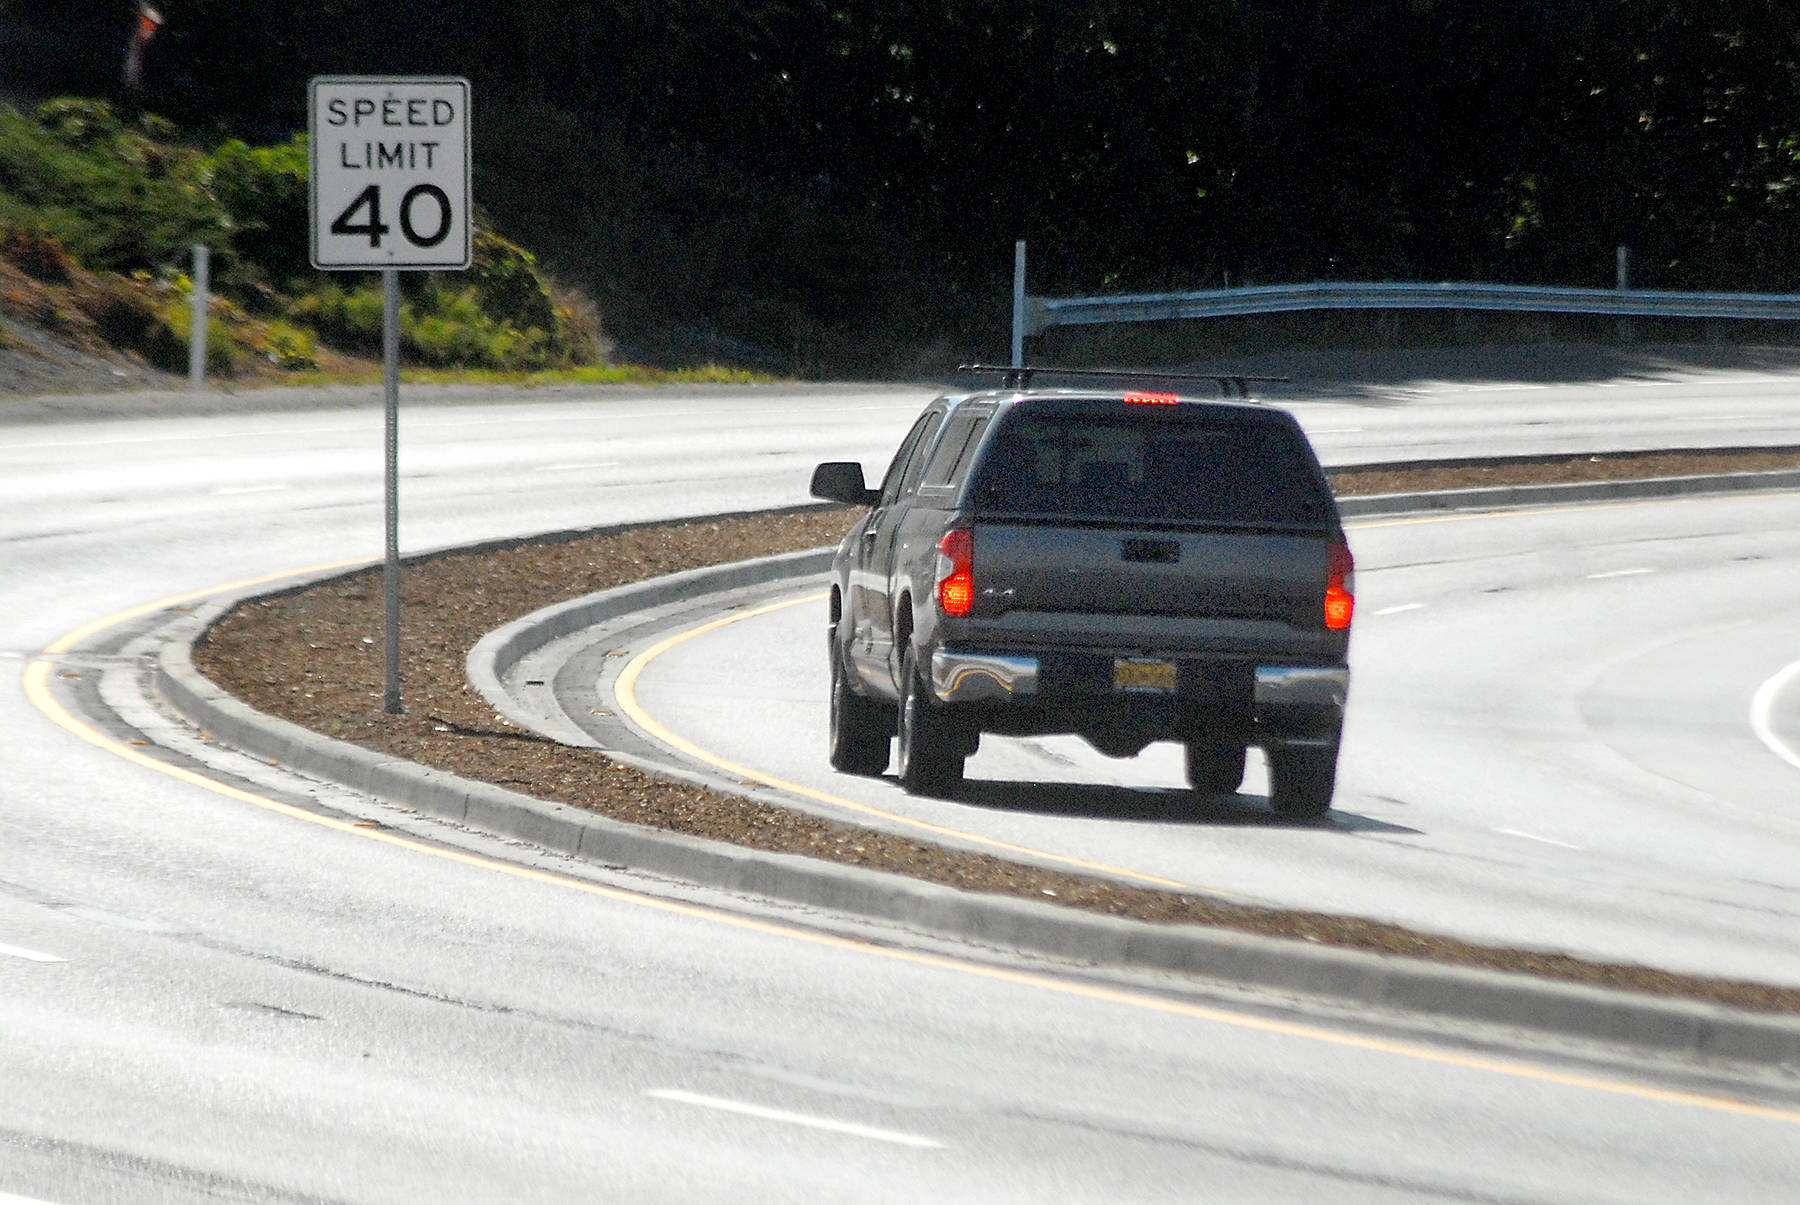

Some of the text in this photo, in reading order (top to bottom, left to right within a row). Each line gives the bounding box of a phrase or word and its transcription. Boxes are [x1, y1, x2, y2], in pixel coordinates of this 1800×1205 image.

[327, 99, 455, 126] SPEED
[341, 142, 440, 169] LIMIT
[330, 183, 453, 248] 40
